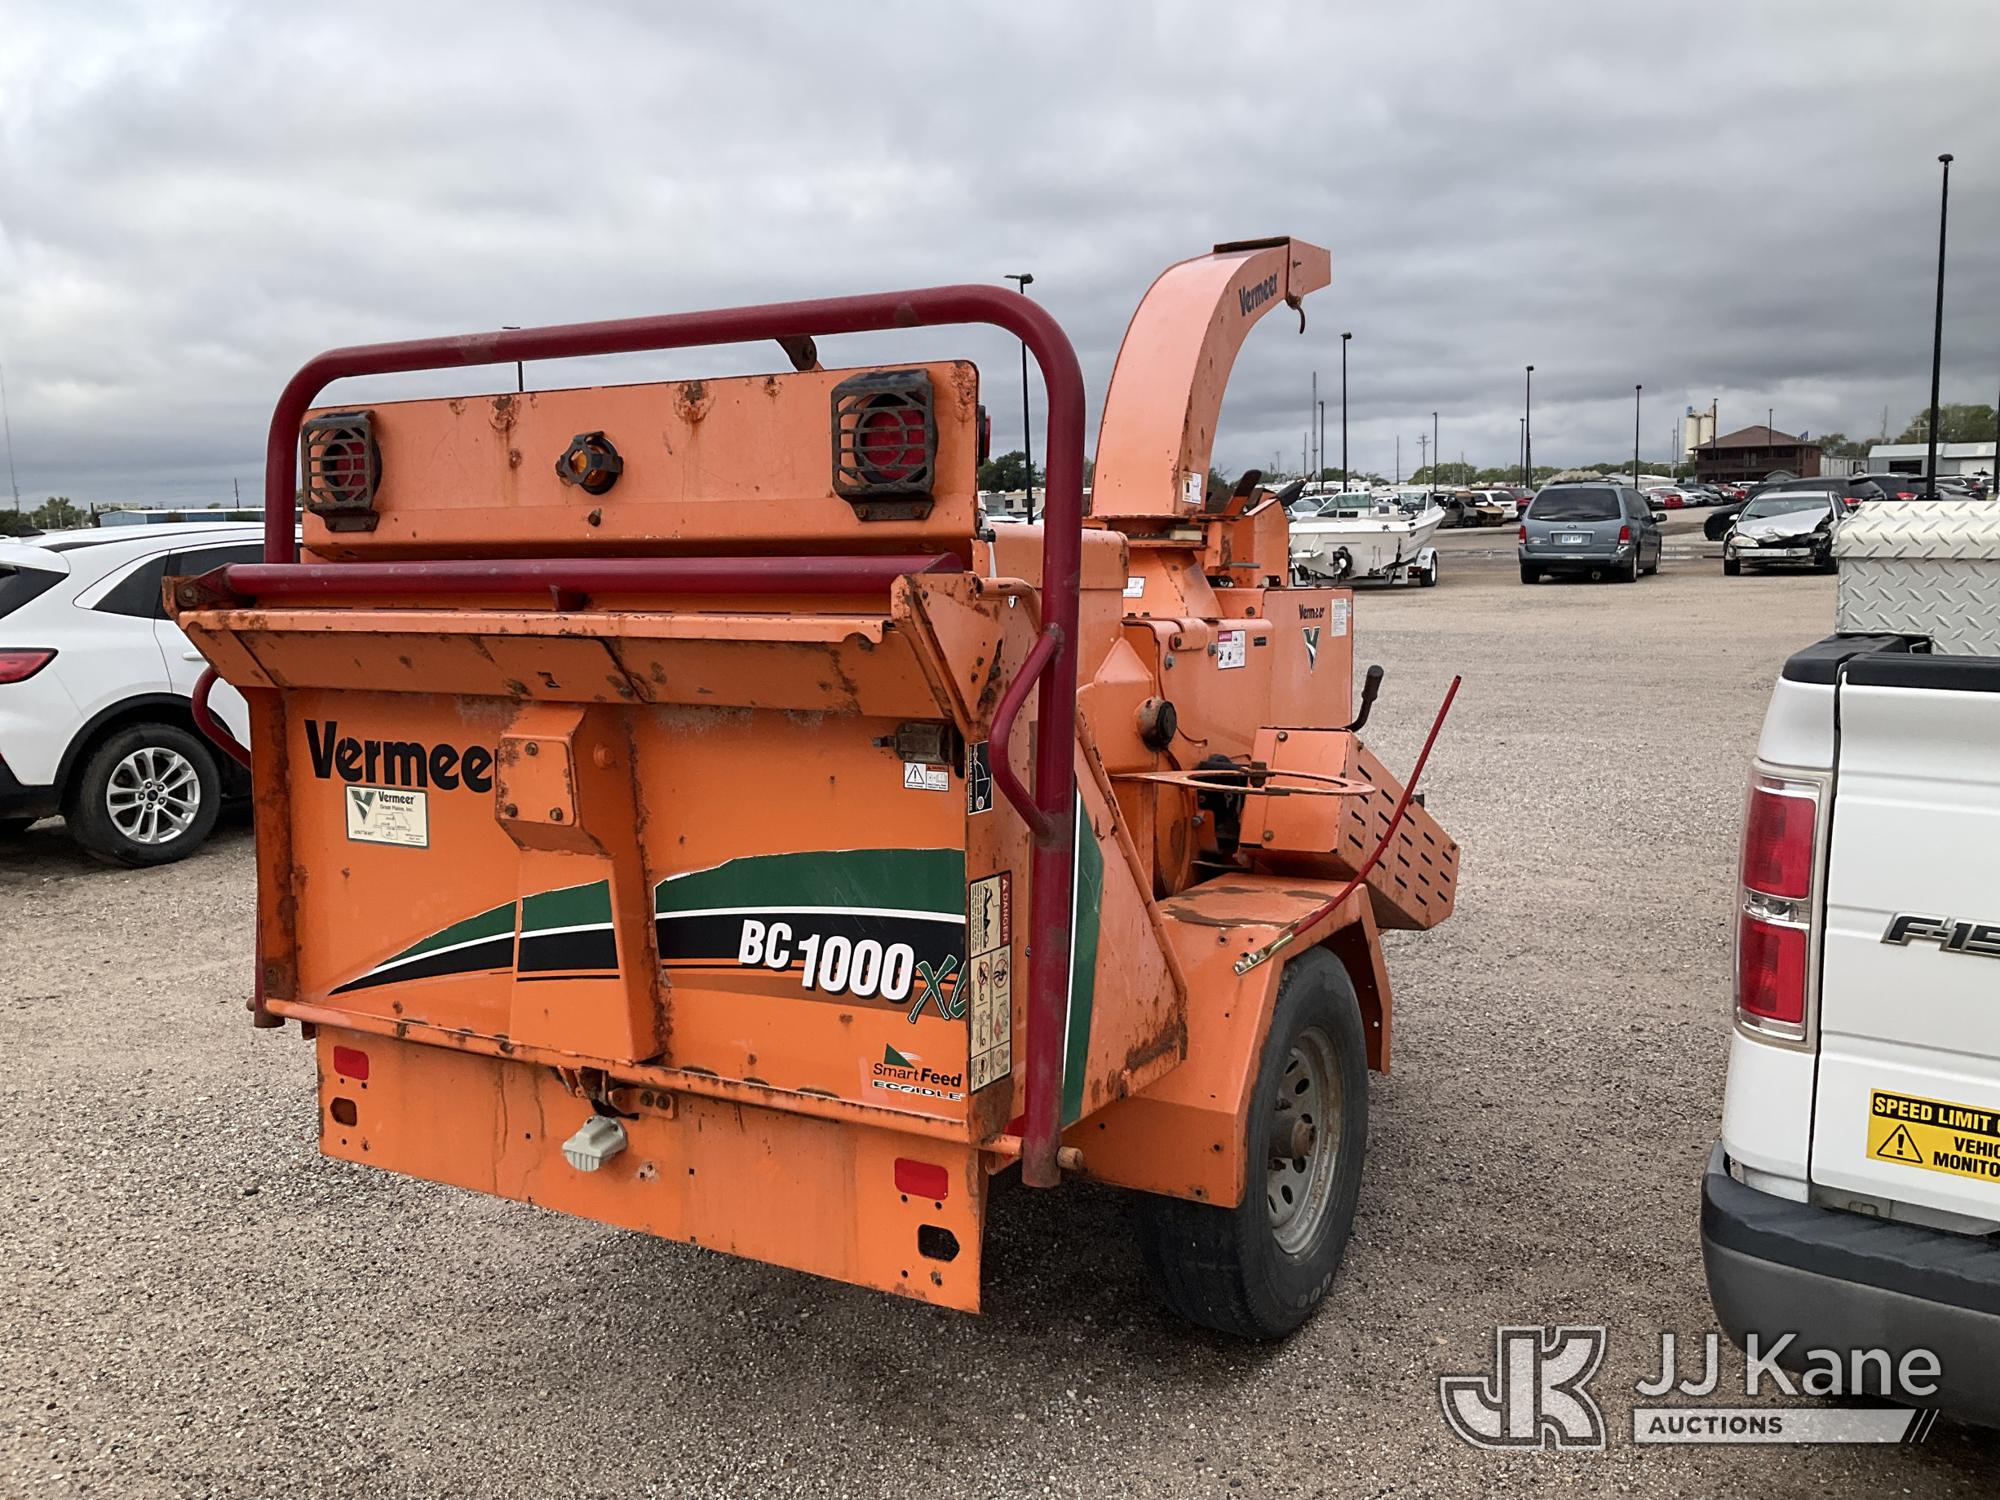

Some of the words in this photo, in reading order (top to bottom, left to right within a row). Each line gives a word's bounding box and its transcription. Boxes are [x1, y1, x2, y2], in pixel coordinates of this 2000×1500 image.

[1239, 272, 1278, 317] Vermeer
[304, 719, 498, 793] Vermee
[378, 790, 414, 805] Vermeer
[1874, 1096, 1933, 1121] SPEED
[1938, 1107, 1992, 1132] LIMIT
[1933, 1151, 2000, 1178] MONITO
